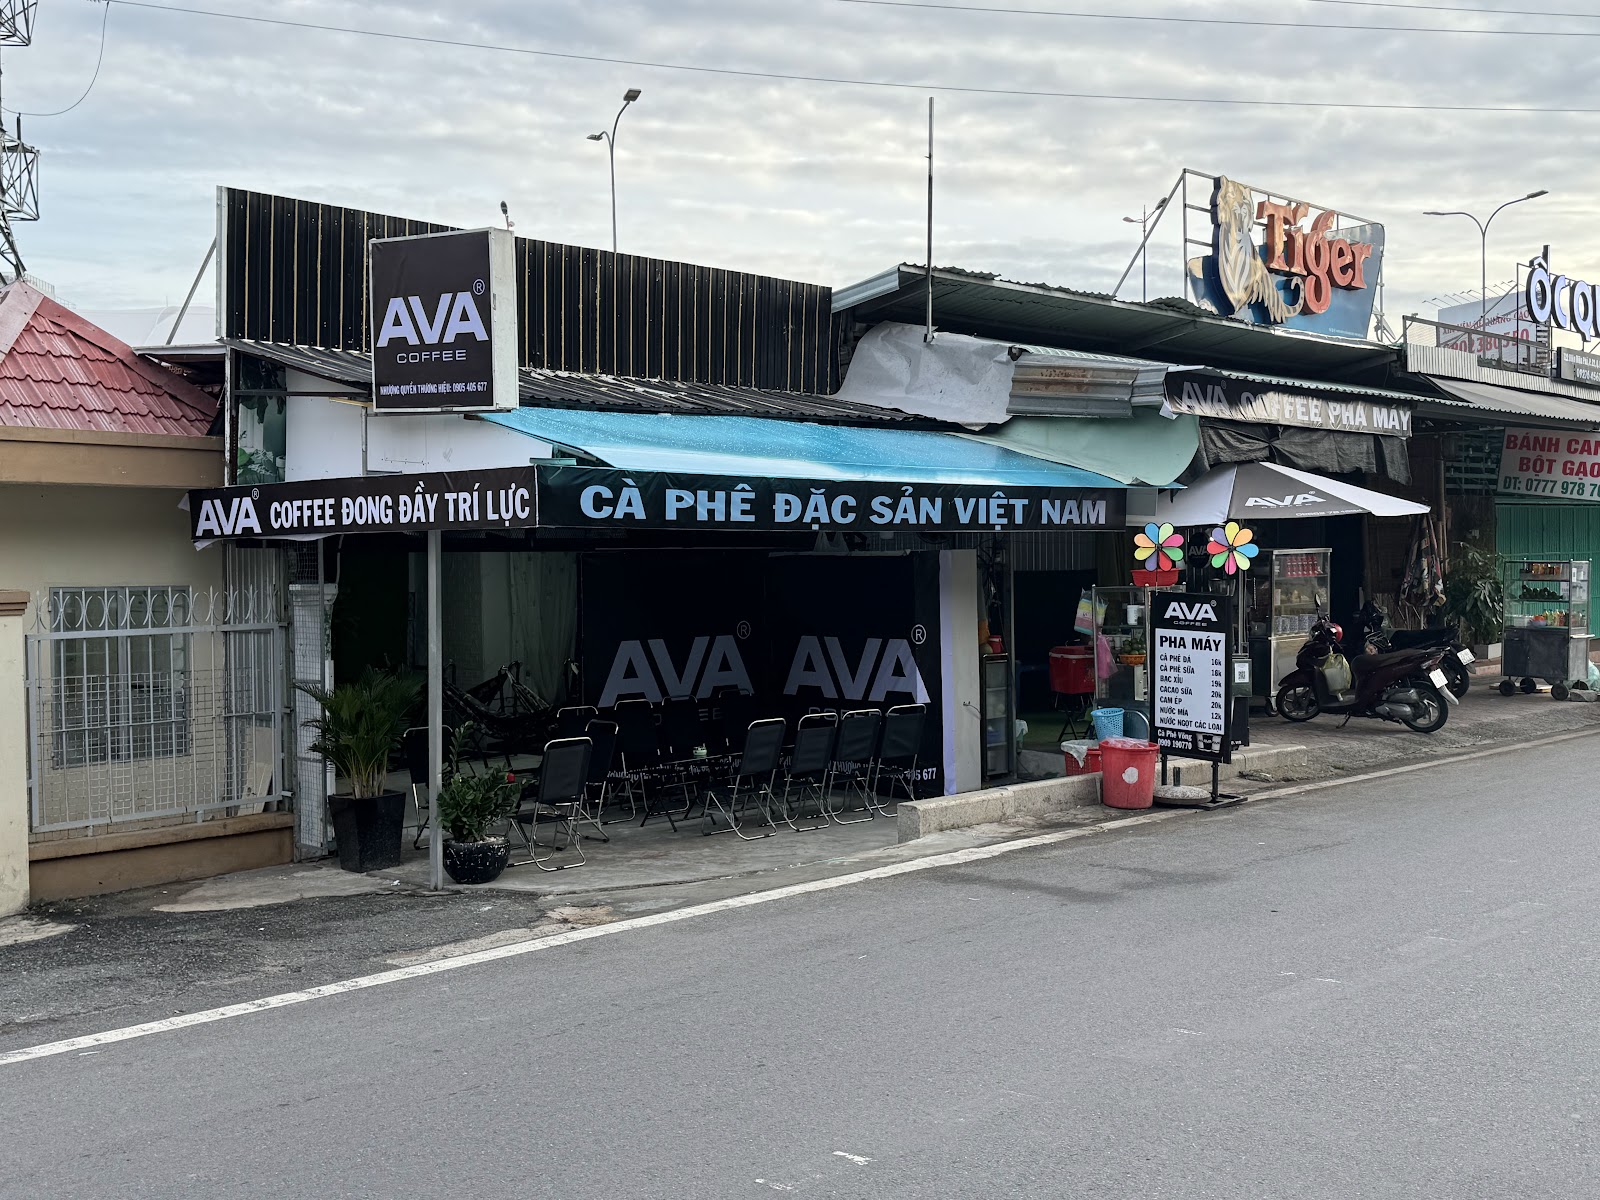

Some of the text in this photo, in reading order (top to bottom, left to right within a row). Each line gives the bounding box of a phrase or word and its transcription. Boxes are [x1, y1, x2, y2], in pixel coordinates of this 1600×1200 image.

[1257, 200, 1372, 314] Tiger
[1526, 245, 1567, 329] ỐC
[376, 292, 489, 347] AVA
[396, 350, 467, 364] COFFEE
[452, 382, 466, 393] 0905
[466, 382, 476, 392] 405
[477, 381, 488, 392] 677
[1182, 381, 1233, 417] AVA
[1327, 402, 1367, 426] PHA
[1372, 404, 1411, 431] MÁY
[1505, 432, 1560, 453] BÁNH
[1518, 454, 1600, 481] BỘT GẠO
[1525, 478, 1558, 494] 0777
[1561, 480, 1585, 496] 978
[195, 480, 530, 537] AVA COFFEE ĐONG ĐẦY TRÍ LỰC
[580, 478, 1107, 531] CÀ PHÊ ĐẶC SẢN VIỆT NAM
[1244, 493, 1327, 507] AVA
[1163, 601, 1218, 622] AVA
[1159, 635, 1222, 652] PHA MÁY
[1169, 654, 1181, 663] PHÊ
[1169, 664, 1181, 673] PHÊ
[597, 635, 754, 707] AVA
[783, 635, 931, 704] AVA
[1159, 685, 1179, 694] CACAO
[1211, 690, 1222, 698] 20k
[1159, 696, 1173, 704] CAM
[1211, 701, 1222, 709] 20k
[922, 767, 937, 780] 677
